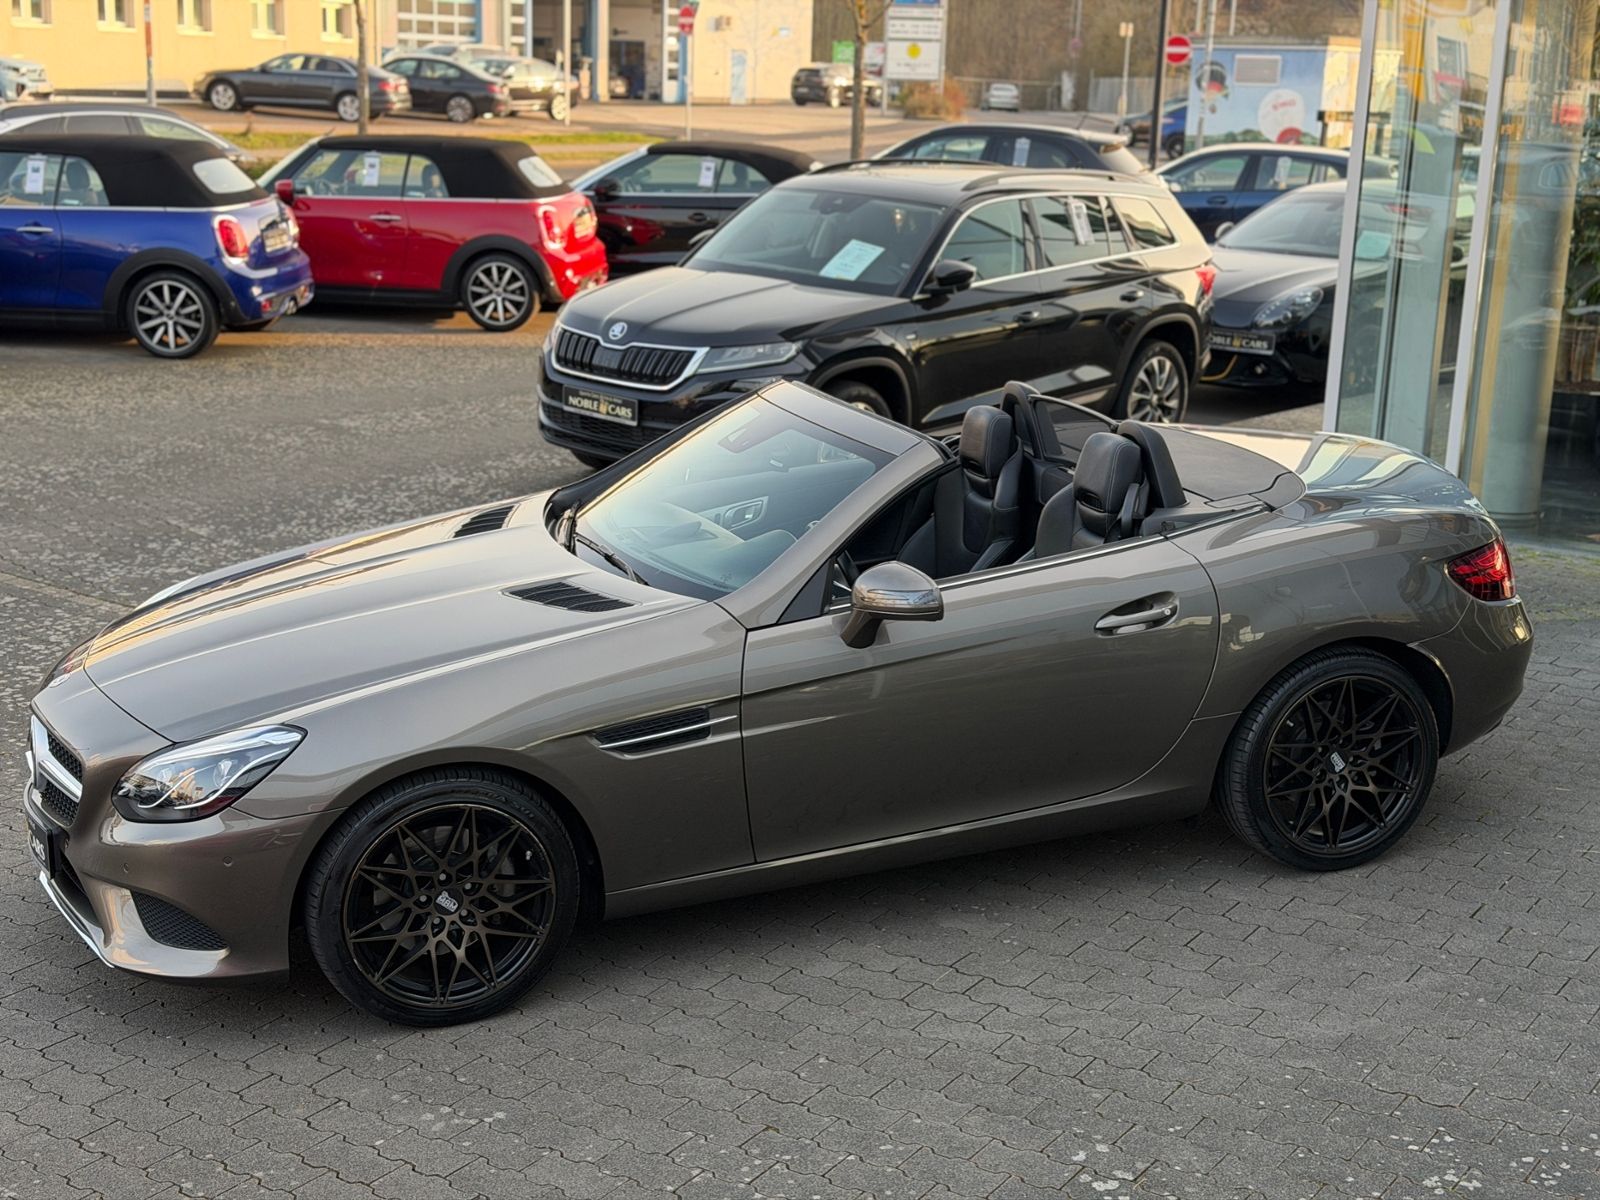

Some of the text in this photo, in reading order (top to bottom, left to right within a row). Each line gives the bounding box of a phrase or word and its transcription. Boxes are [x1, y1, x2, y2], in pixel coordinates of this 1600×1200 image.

[1241, 338, 1269, 350] CARS
[567, 395, 599, 412] NOBLE
[607, 403, 633, 419] CARS
